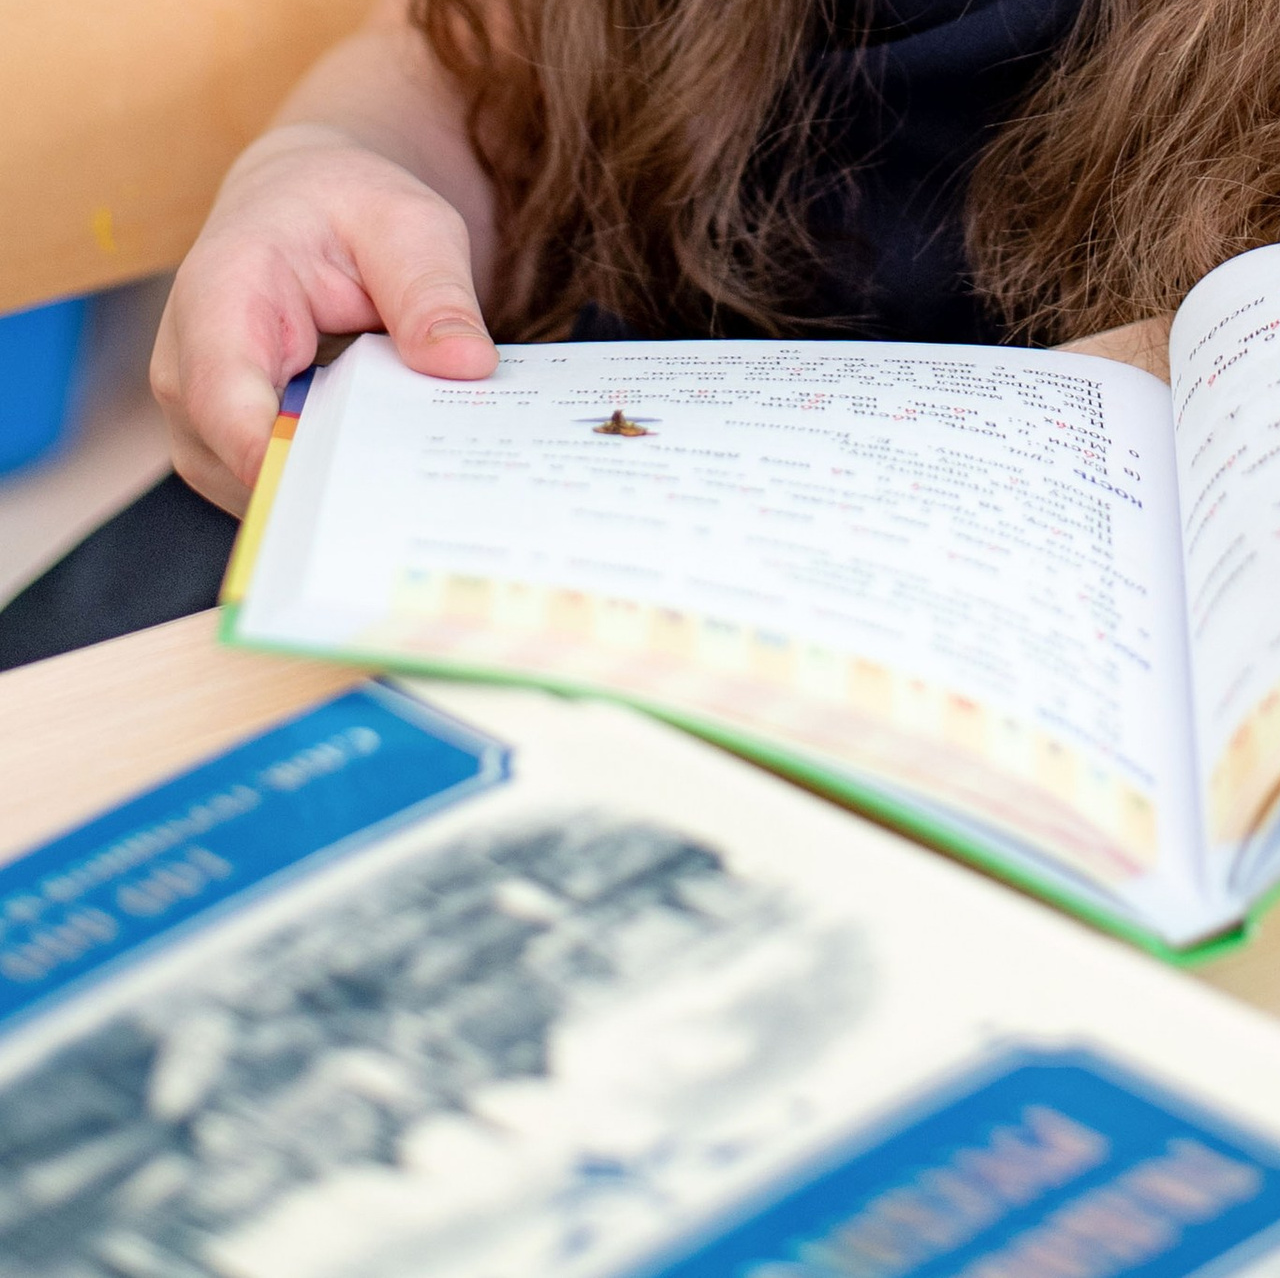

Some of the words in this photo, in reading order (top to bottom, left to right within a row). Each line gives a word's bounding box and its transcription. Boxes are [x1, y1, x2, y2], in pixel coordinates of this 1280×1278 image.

[1023, 369, 1102, 389] Доколе
[1035, 379, 1101, 399] Повис
[1024, 400, 1061, 413] как
[1057, 390, 1102, 409] Пёс,
[1064, 401, 1104, 419] Как
[938, 420, 1006, 439] кость,
[1128, 449, 1139, 459] о
[1073, 469, 1142, 509] кость
